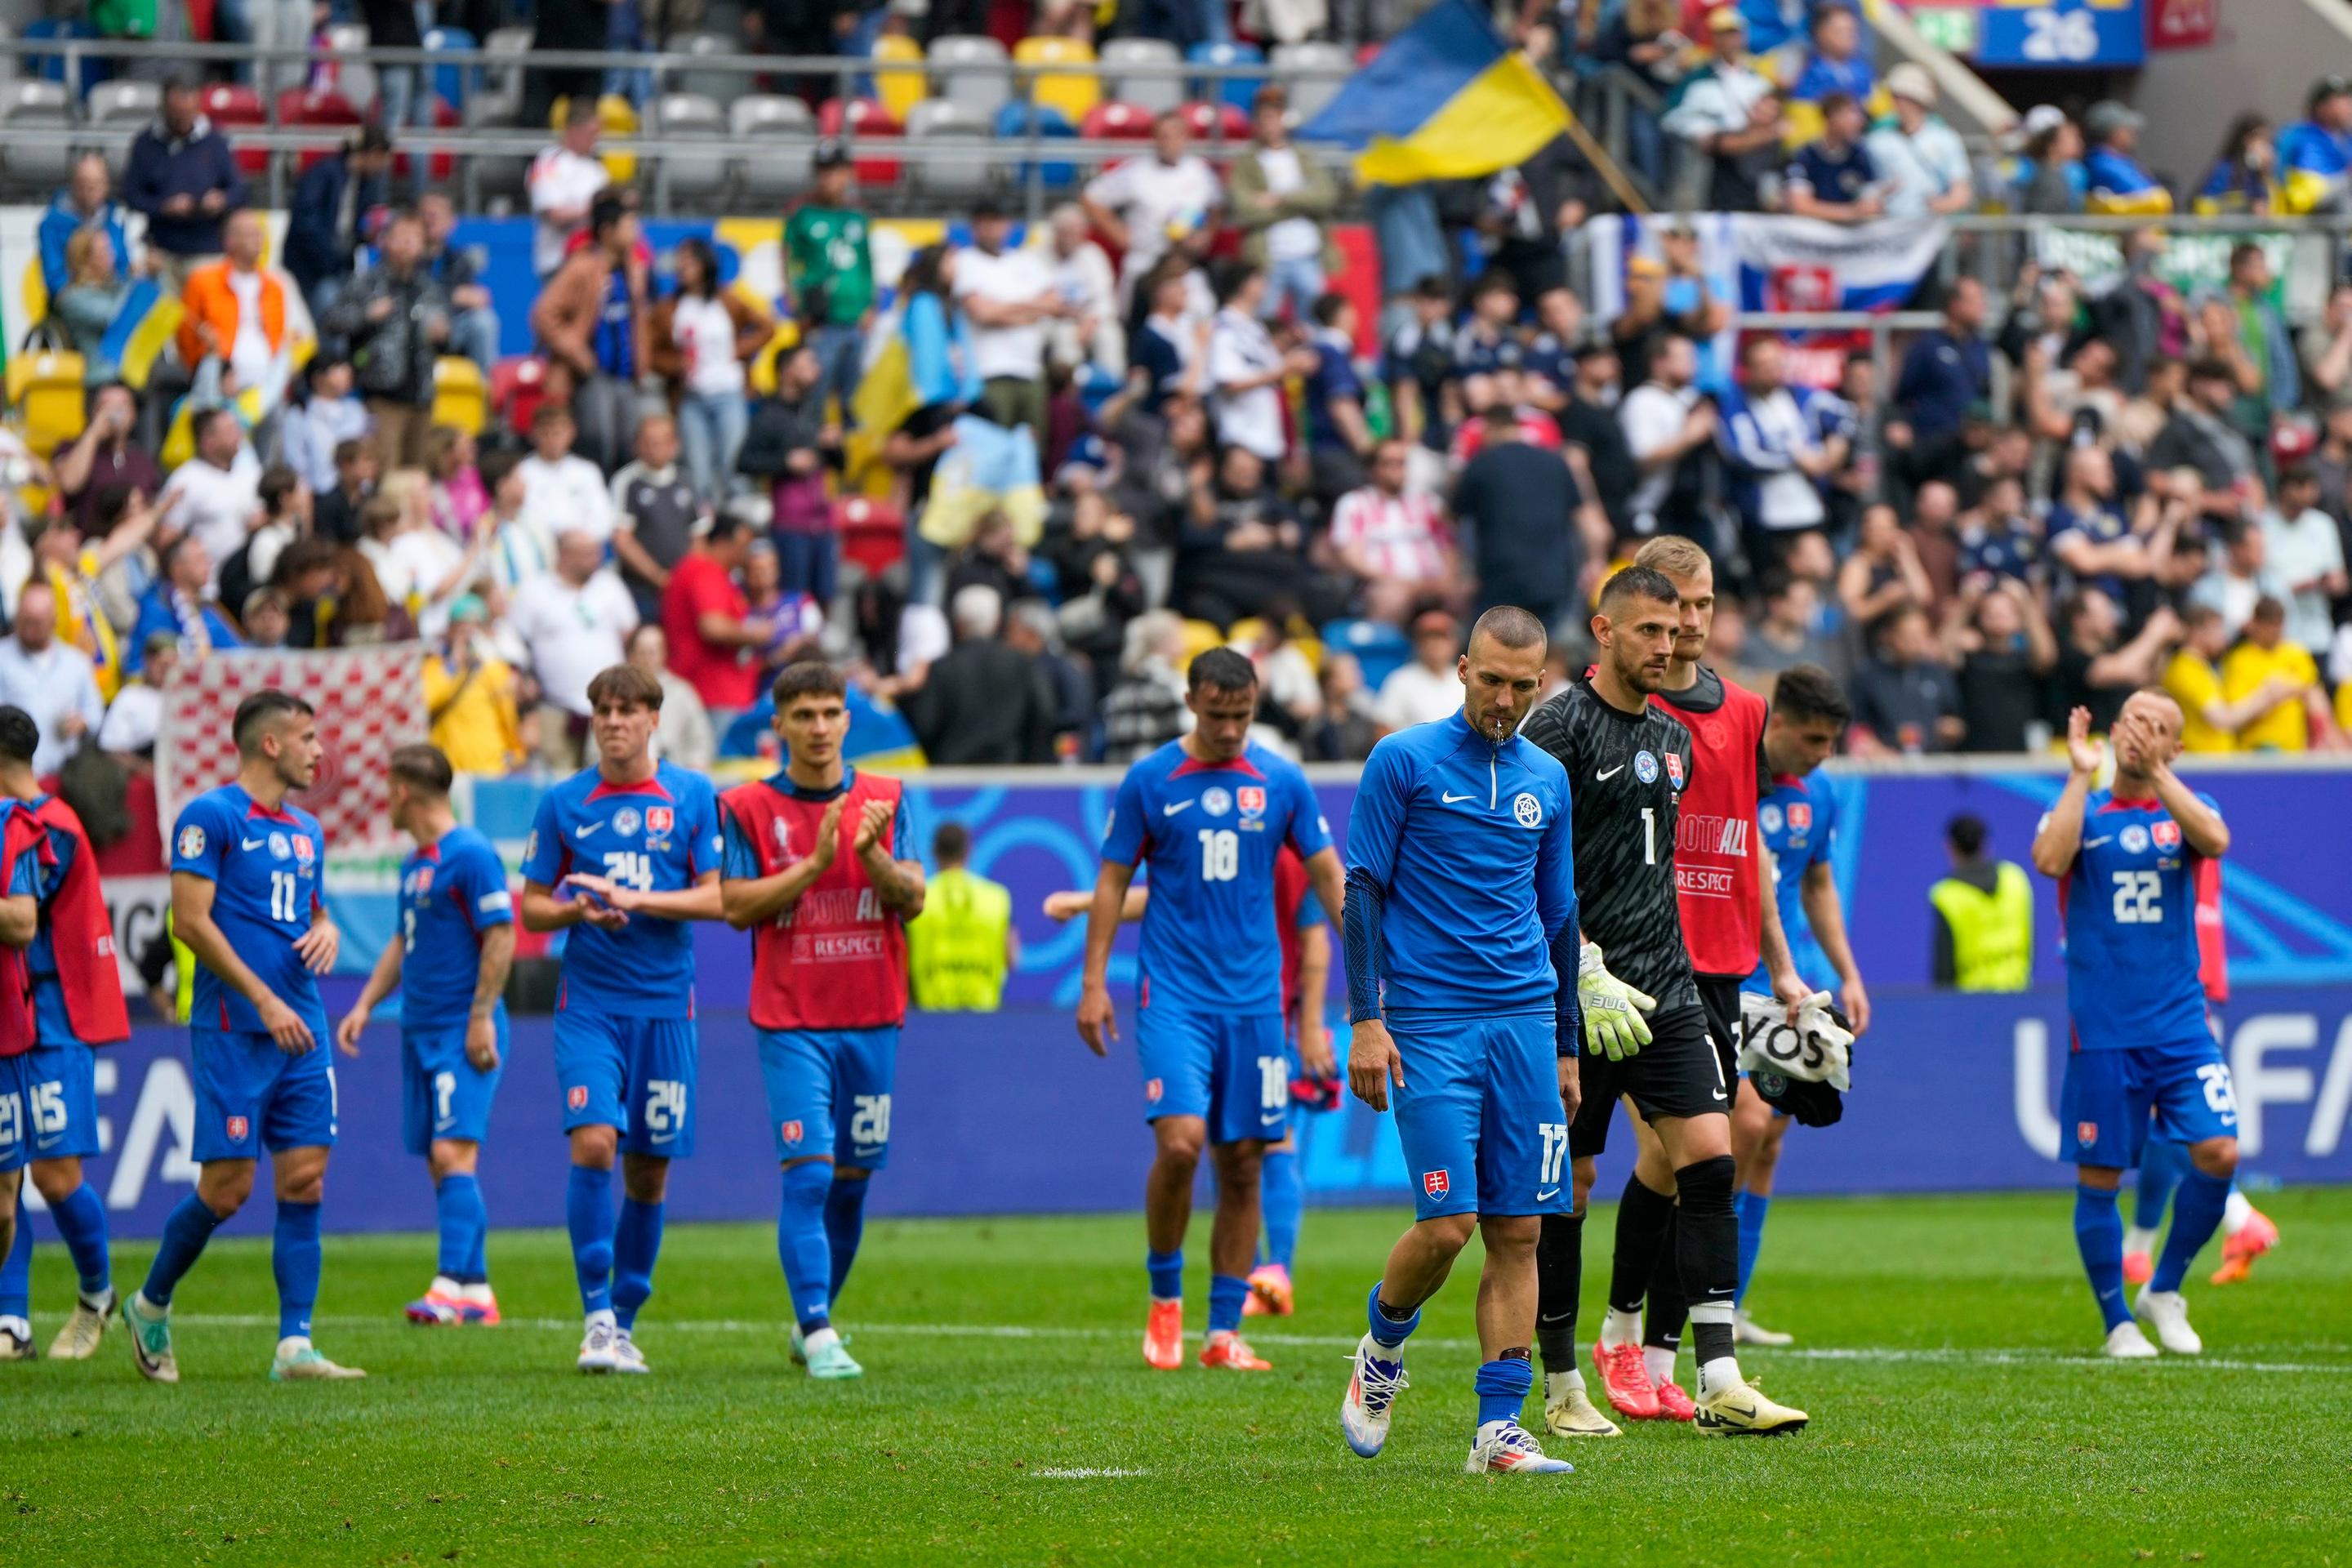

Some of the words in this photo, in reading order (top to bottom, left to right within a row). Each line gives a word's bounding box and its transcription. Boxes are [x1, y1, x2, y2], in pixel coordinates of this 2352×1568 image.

[2022, 8, 2100, 61] 26
[1198, 829, 1239, 882] 18
[1642, 808, 1656, 865] 1
[270, 870, 296, 923] 11
[1677, 870, 1733, 892] RESPECT
[2112, 870, 2163, 924] 22
[814, 936, 883, 956] RESPECT
[1741, 1012, 1824, 1069] VOS
[29, 1080, 68, 1134] 15
[645, 1079, 687, 1130] 24
[851, 1094, 891, 1143] 20
[1539, 1123, 1568, 1184] 17
